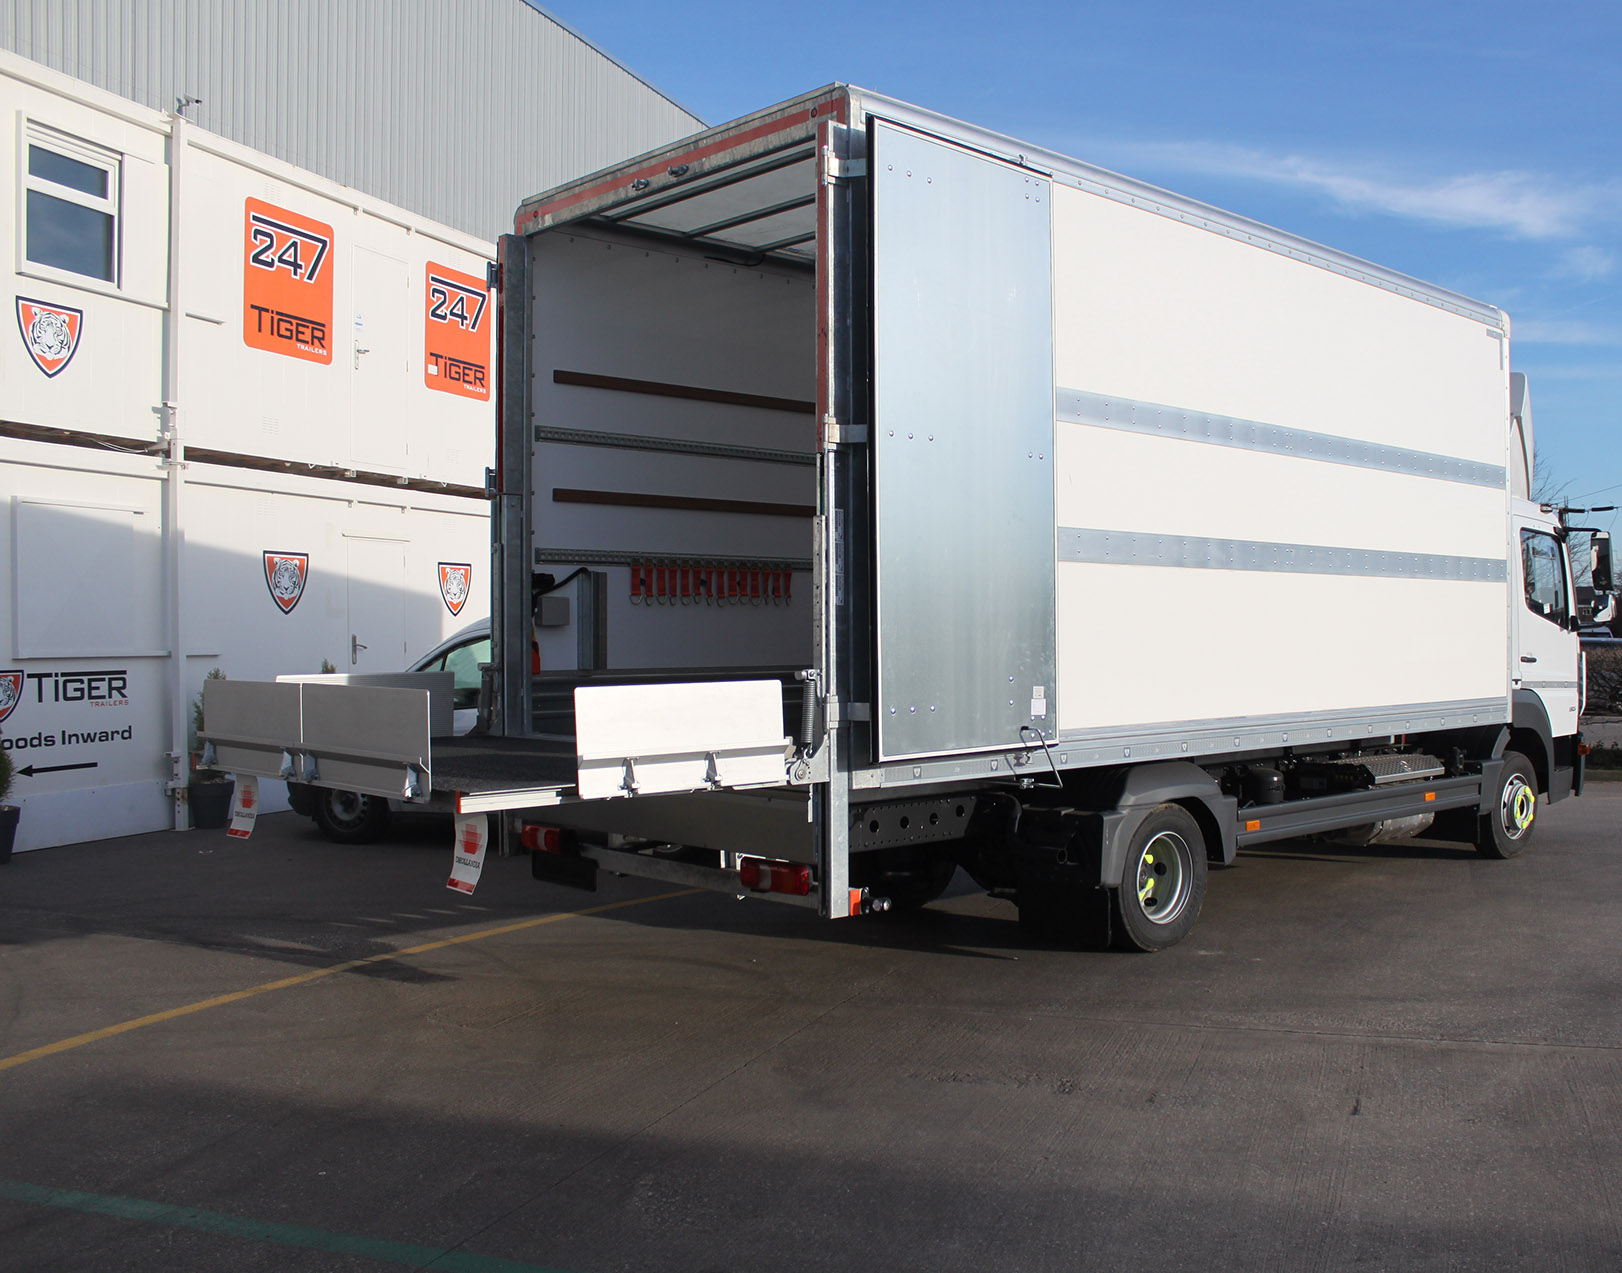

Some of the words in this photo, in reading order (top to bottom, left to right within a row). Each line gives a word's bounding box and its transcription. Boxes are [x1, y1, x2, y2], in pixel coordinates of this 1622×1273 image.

[250, 211, 330, 284] 247
[429, 273, 488, 333] 247
[297, 343, 328, 356] TRAILERS
[463, 383, 487, 394] TRAILERS
[1, 732, 56, 751] oods
[61, 725, 132, 745] Inward
